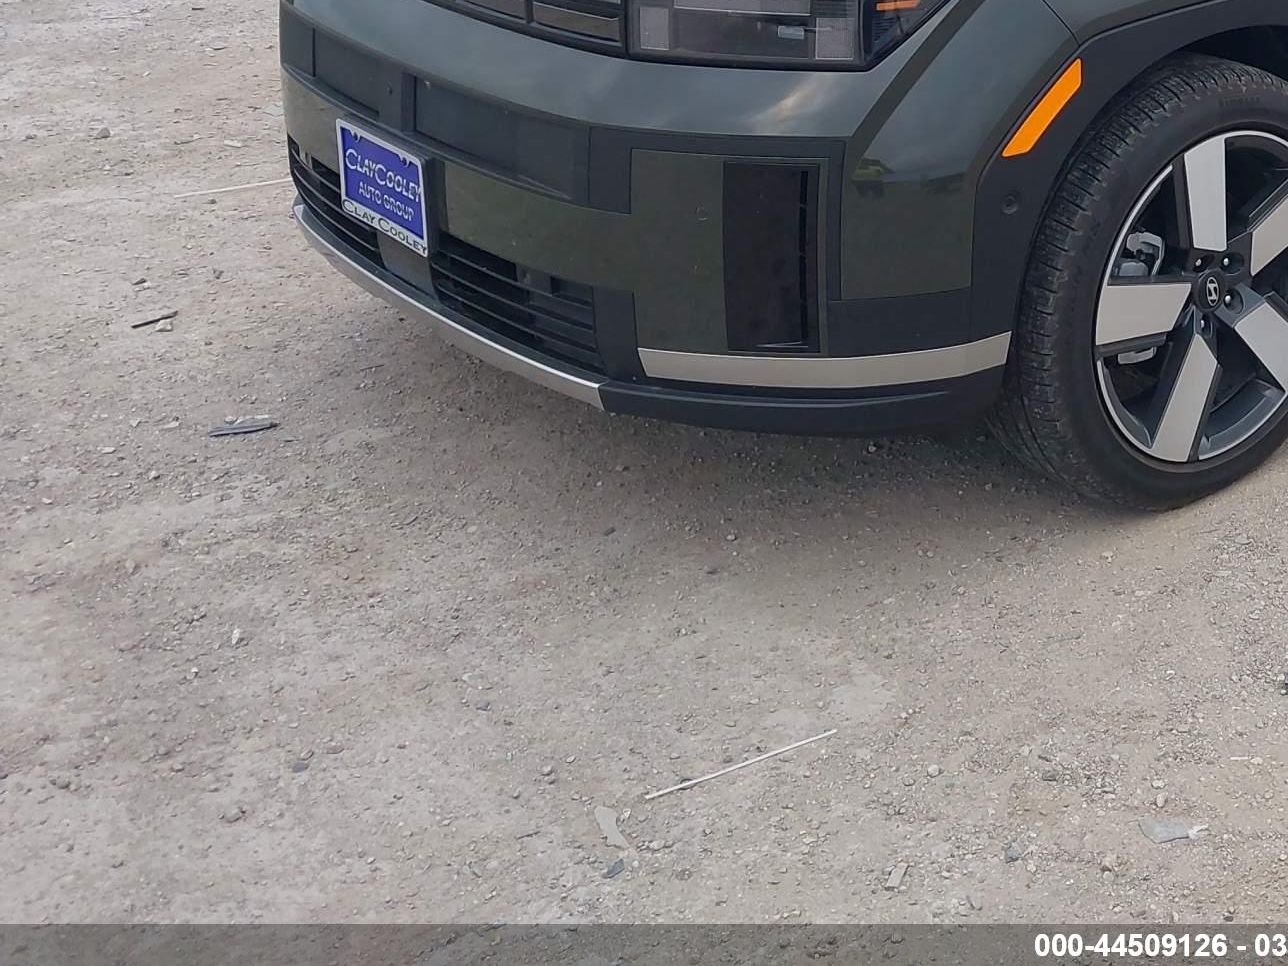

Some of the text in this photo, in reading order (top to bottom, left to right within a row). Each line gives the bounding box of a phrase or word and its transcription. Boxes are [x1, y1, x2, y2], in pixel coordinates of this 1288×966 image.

[358, 181, 415, 222] AUTO GROUP
[342, 199, 427, 254] CLAY COOLEY
